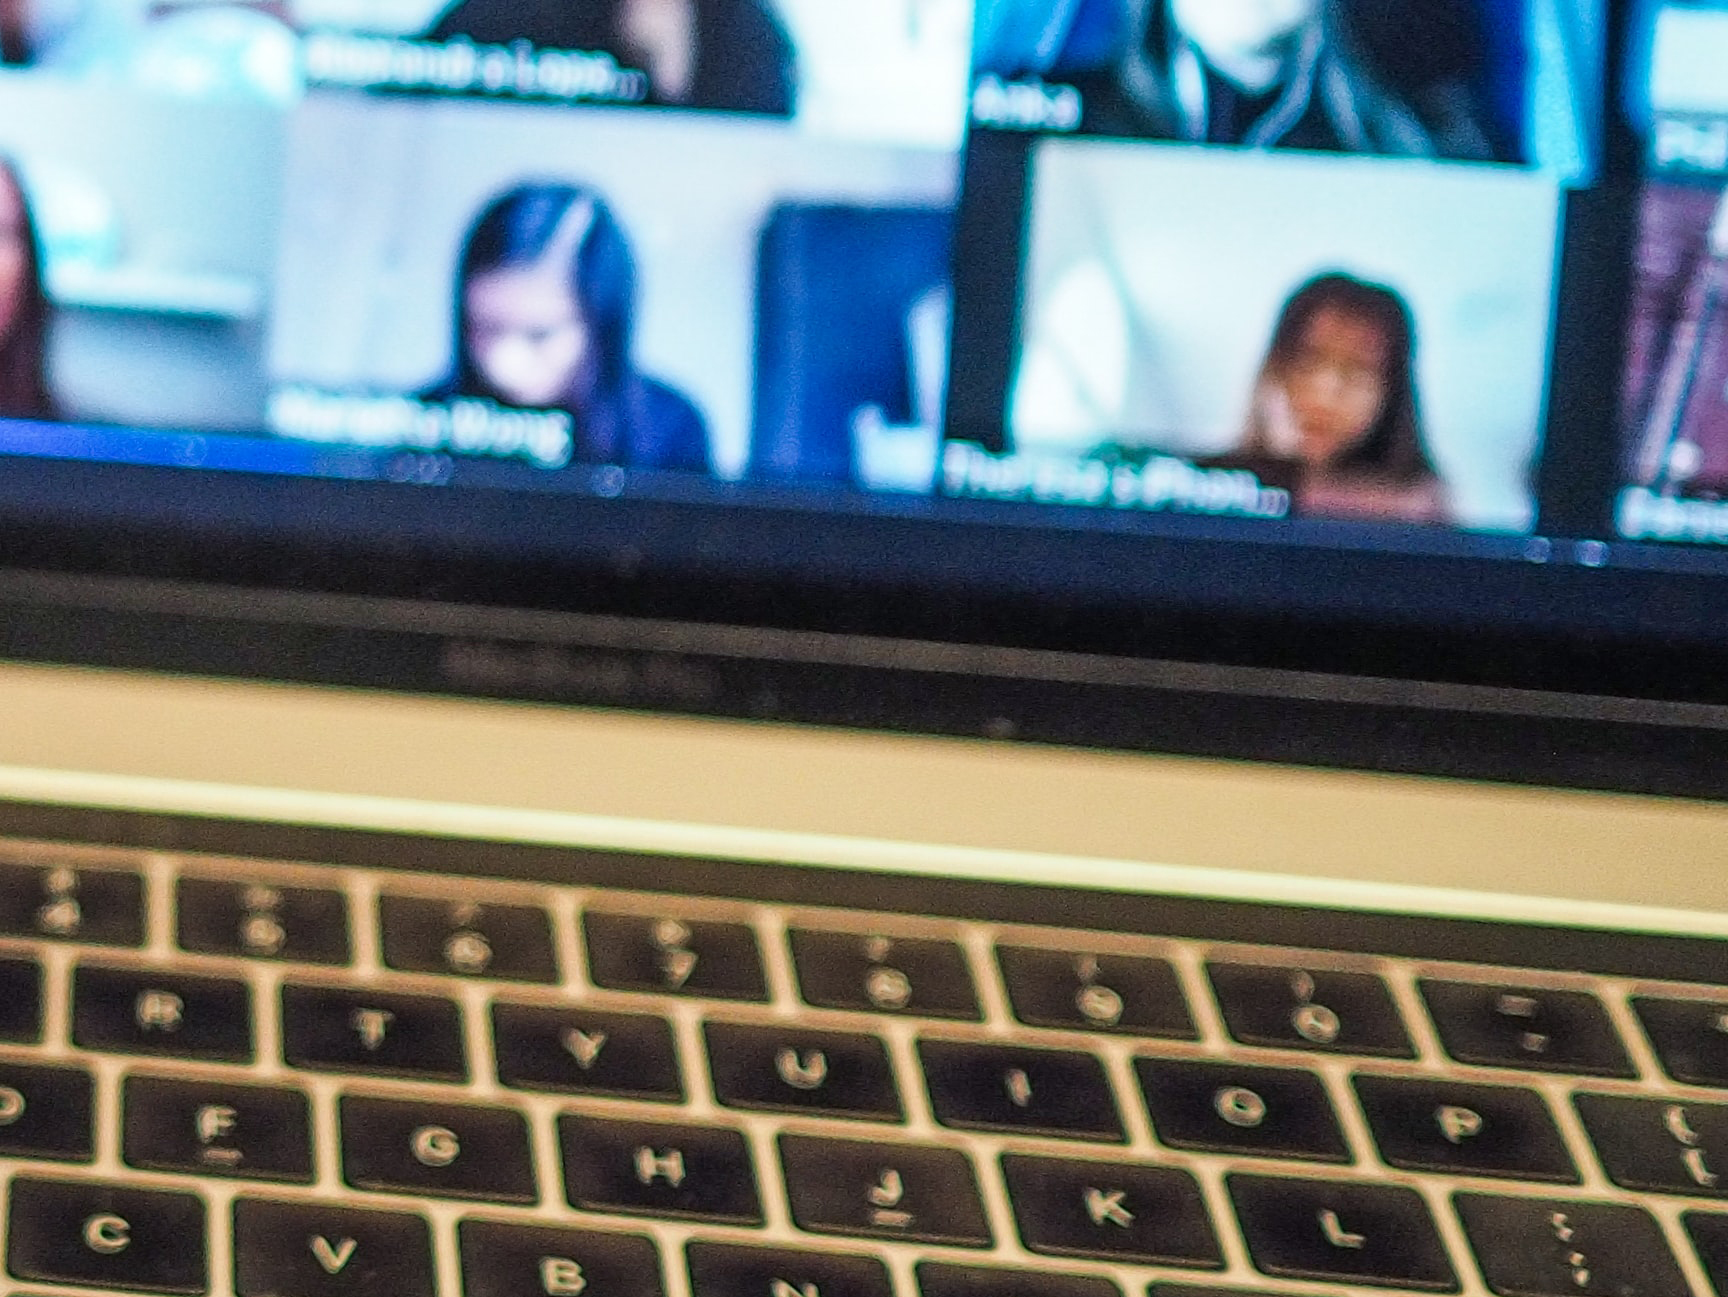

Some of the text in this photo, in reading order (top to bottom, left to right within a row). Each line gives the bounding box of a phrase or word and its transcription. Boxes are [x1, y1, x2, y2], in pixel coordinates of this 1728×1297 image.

[137, 991, 182, 1031] R
[355, 1008, 395, 1050] T
[563, 1027, 607, 1067] Y
[776, 1047, 827, 1089] U
[197, 1106, 236, 1142] F
[1215, 1086, 1266, 1127] O
[1437, 1105, 1482, 1143] P
[411, 1126, 460, 1167] G
[635, 1146, 686, 1188] H
[868, 1169, 903, 1205] J
[1085, 1187, 1134, 1227] K
[83, 1214, 130, 1253] C
[1319, 1209, 1366, 1248] L
[312, 1234, 357, 1273] V
[540, 1257, 587, 1297] B
